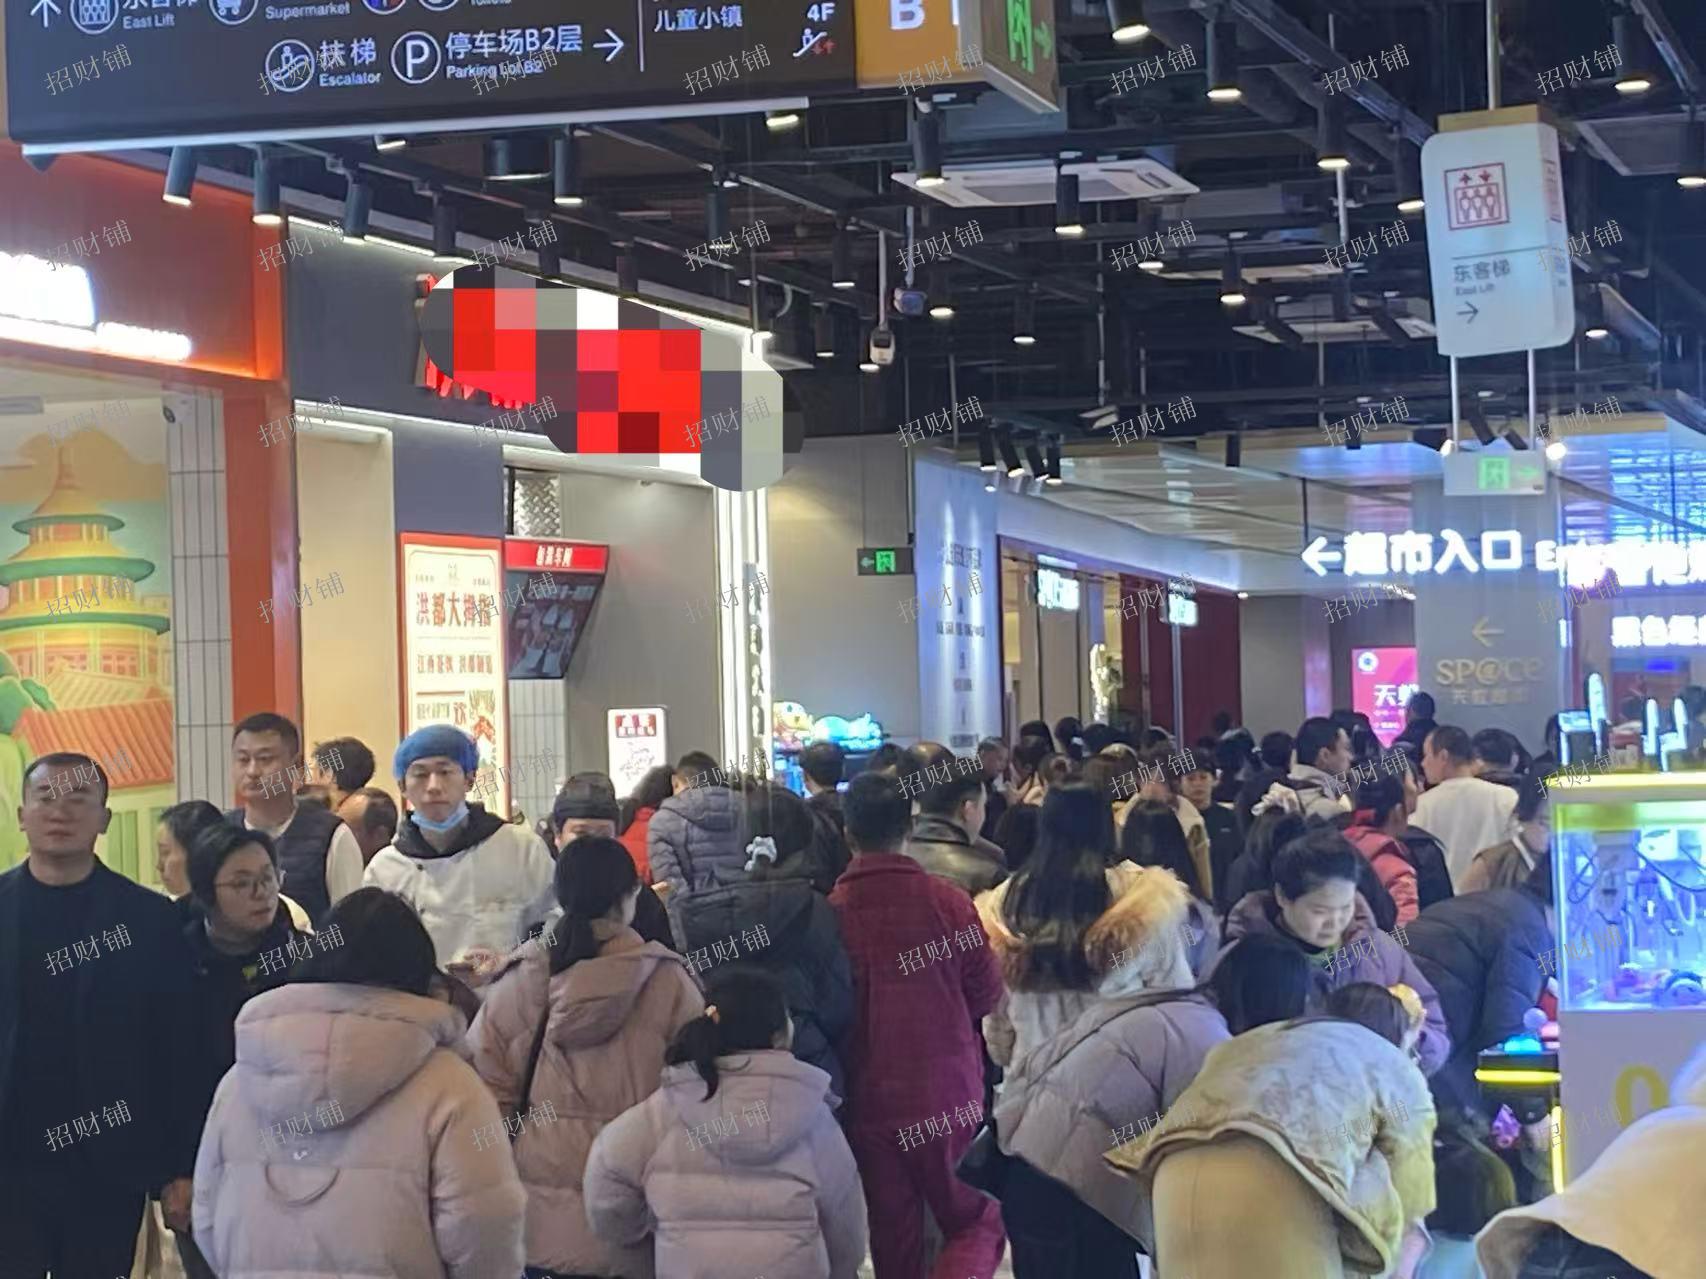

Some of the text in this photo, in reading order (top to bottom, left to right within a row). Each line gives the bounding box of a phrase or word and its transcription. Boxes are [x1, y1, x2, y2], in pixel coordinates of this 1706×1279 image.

[265, 3, 351, 19] Supermarket
[654, 5, 742, 32] 儿童小镇
[807, 3, 835, 21] 4F
[319, 37, 377, 66] 扶梯
[445, 26, 583, 60] 停车场B2层
[319, 72, 381, 86] Escalator
[446, 64, 498, 79] Parking
[523, 58, 543, 73] B2
[1453, 259, 1511, 284] 东客梯
